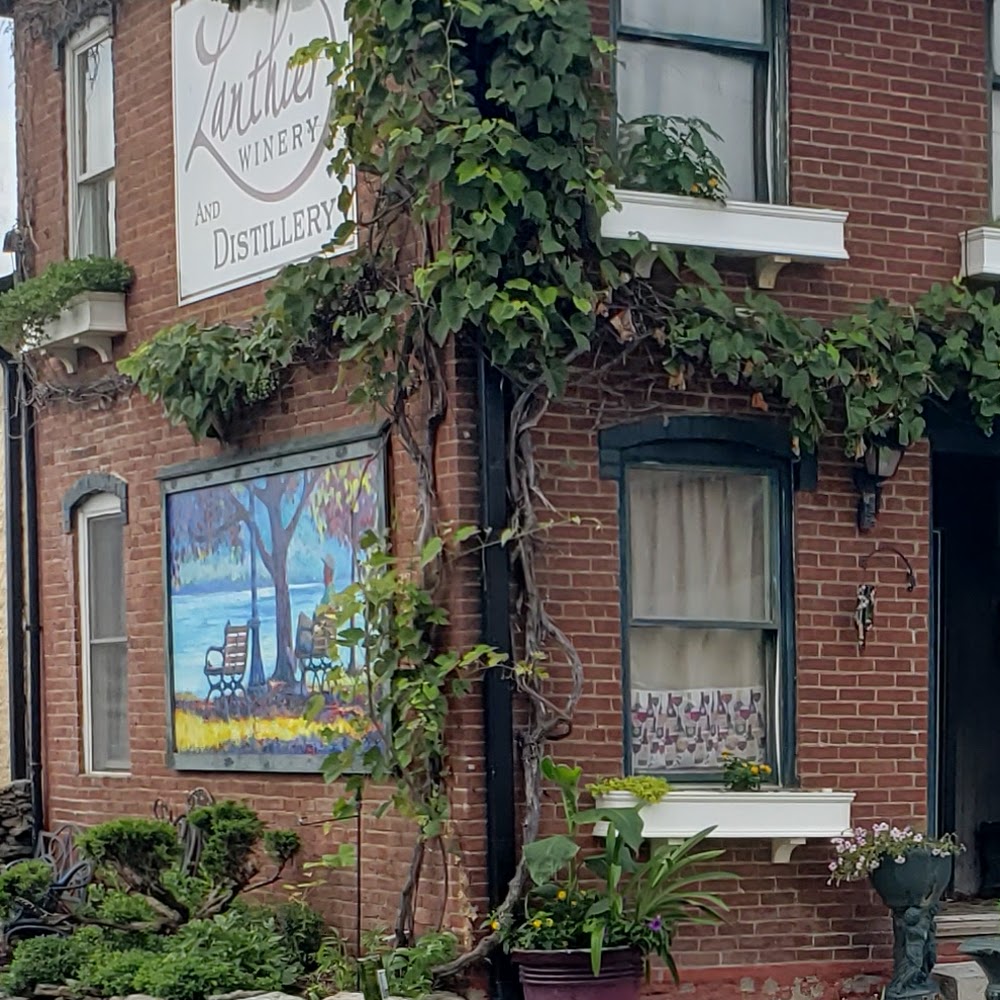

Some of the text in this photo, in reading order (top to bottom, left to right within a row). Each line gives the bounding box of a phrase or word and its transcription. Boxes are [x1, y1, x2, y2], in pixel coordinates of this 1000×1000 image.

[238, 116, 319, 172] WINERY
[195, 201, 221, 226] AND
[213, 198, 337, 270] DISTILLERY
